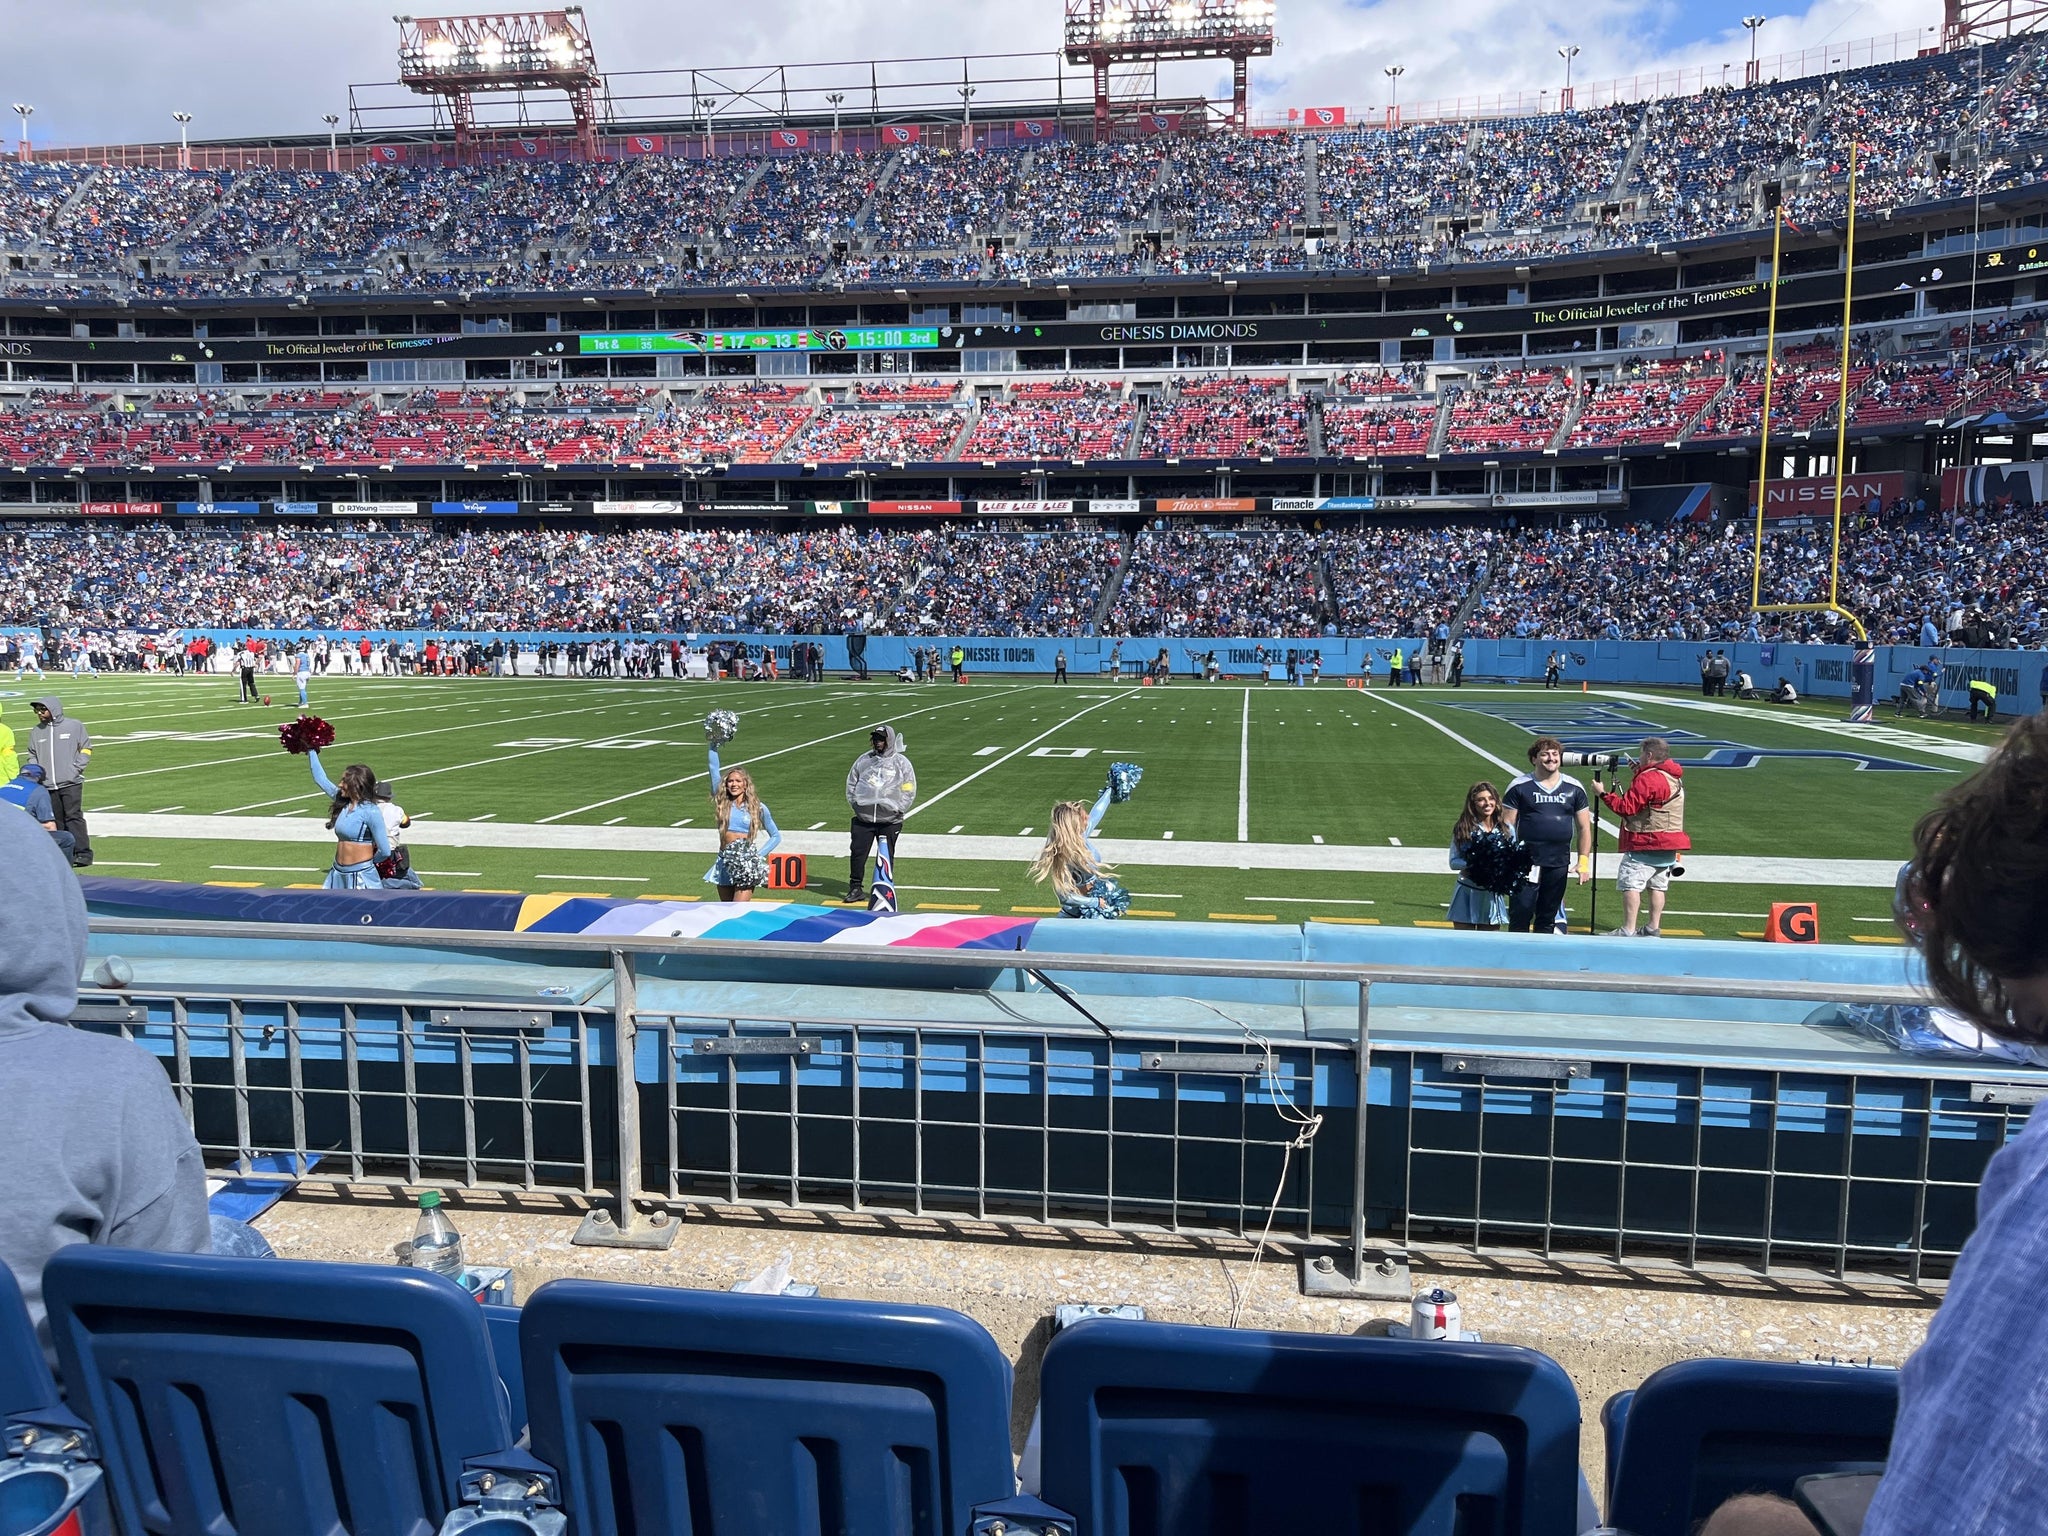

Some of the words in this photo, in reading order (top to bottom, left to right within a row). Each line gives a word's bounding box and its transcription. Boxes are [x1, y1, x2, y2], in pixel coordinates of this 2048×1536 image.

[1533, 311, 1556, 323] The
[1558, 306, 1603, 322] Official
[1606, 301, 1650, 317] Jeweler
[1652, 298, 1667, 311] of
[1668, 295, 1689, 308] the
[1691, 283, 1757, 304] Tennessee
[858, 331, 902, 346] 15:00
[909, 332, 931, 344] 3rd
[1100, 325, 1165, 341] GENESIS
[1170, 323, 1258, 339] DIAMONDS
[266, 344, 284, 355] The
[286, 343, 321, 355] Official
[322, 342, 355, 354] Jeweler
[357, 341, 367, 352] of
[368, 341, 384, 351] the
[385, 338, 433, 350] Tennessee
[594, 339, 609, 350] 1st
[641, 341, 652, 350] 35
[729, 335, 746, 349] 17
[774, 334, 791, 348] 13
[1767, 482, 1882, 503] NISSAN
[346, 504, 378, 513] RJYoung
[990, 502, 1008, 510] LEE
[1021, 502, 1039, 510] LEE
[1172, 499, 1200, 511] Tito's
[1274, 499, 1314, 510] Pinnacle
[1532, 791, 1566, 804] TITANS
[771, 855, 803, 888] 10
[1778, 905, 1816, 942] G
